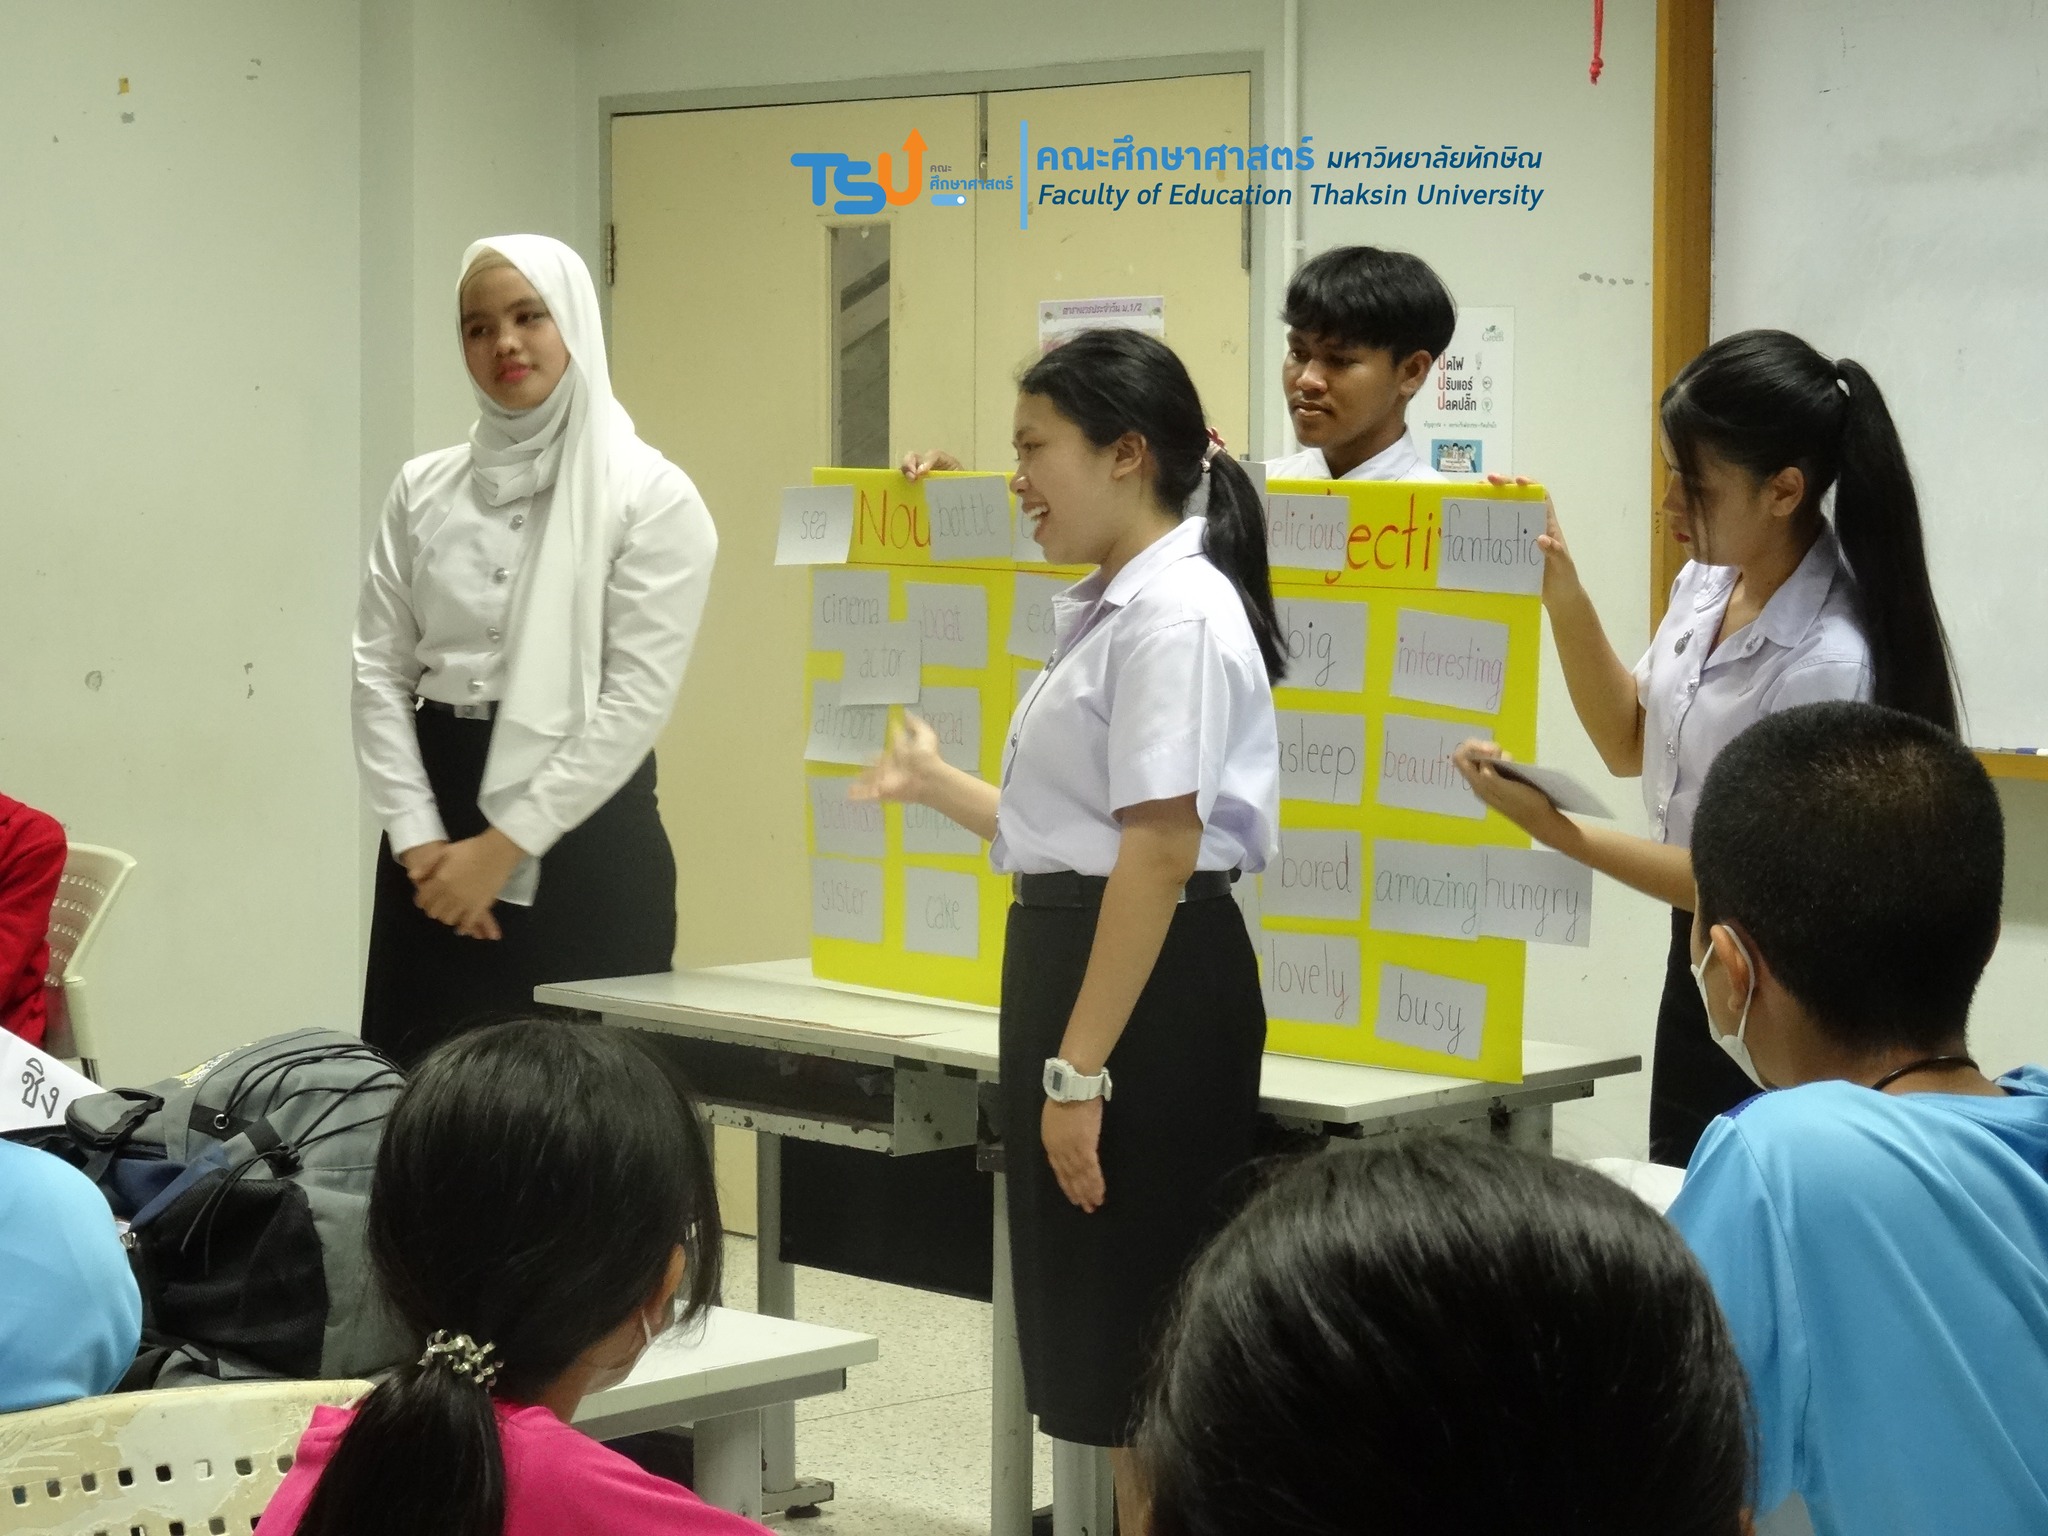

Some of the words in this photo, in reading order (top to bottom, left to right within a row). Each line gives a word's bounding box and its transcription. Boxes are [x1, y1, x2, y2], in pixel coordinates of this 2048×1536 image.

[799, 508, 828, 541] sea
[859, 489, 931, 550] Nou
[937, 493, 996, 538] bottle
[1444, 502, 1541, 567] fantastic
[822, 592, 880, 626] cinema
[922, 600, 965, 642] boat
[859, 642, 907, 679] actor
[1287, 608, 1336, 688] big
[1398, 632, 1502, 709] interesting
[1281, 840, 1352, 894] bored
[820, 879, 868, 917] sister
[925, 894, 961, 932] cake
[1375, 872, 1478, 934] amazing
[1483, 853, 1580, 942] hungry
[1271, 940, 1350, 1021] lovely
[1396, 973, 1466, 1055] busy
